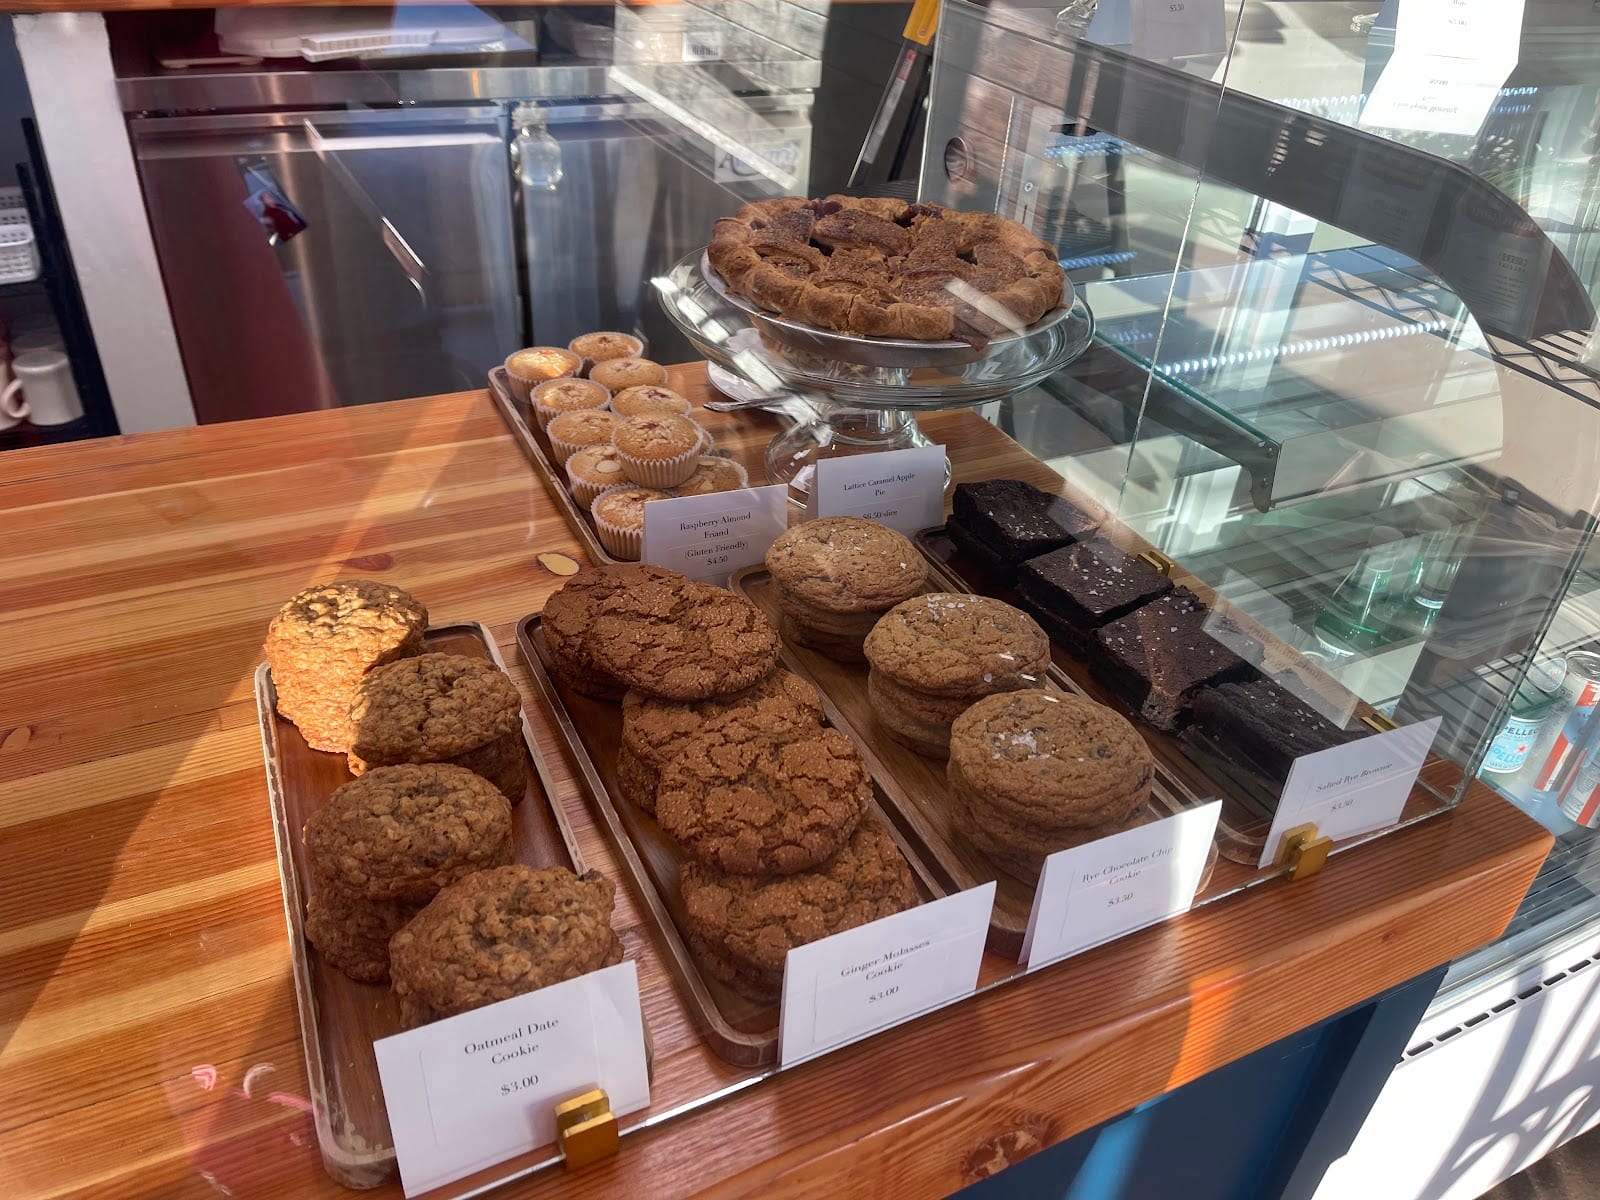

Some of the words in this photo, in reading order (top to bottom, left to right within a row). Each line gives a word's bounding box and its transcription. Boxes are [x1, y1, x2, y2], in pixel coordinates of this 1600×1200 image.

[844, 481, 866, 491] Lattice
[867, 475, 895, 487] Caramel
[896, 472, 916, 483] Apple
[875, 489, 886, 497] Pie
[680, 519, 720, 531] Raspberry
[721, 511, 751, 524] Almond
[704, 528, 729, 539] Friand
[684, 548, 714, 561] (Gluten
[715, 540, 749, 553] Friendly)
[707, 555, 728, 566] $4.50
[1316, 777, 1342, 793] Salted
[1343, 774, 1359, 785] Rye
[1360, 763, 1393, 778] Brownie
[1330, 799, 1354, 813] $3.50
[1082, 871, 1100, 884] Rye
[1103, 855, 1149, 876] Chocolate
[1151, 846, 1174, 859] Chip
[1109, 869, 1142, 885] Cookie
[1107, 892, 1134, 908] $3.50
[840, 957, 881, 977] Ginger
[883, 940, 931, 962] Molasses
[865, 961, 904, 981] Cookie
[868, 985, 900, 1004] $3.00
[464, 1027, 523, 1056] Oatmeal
[527, 1018, 560, 1036] Date
[491, 1043, 540, 1065] Cookie
[500, 1074, 539, 1097] $3.00
